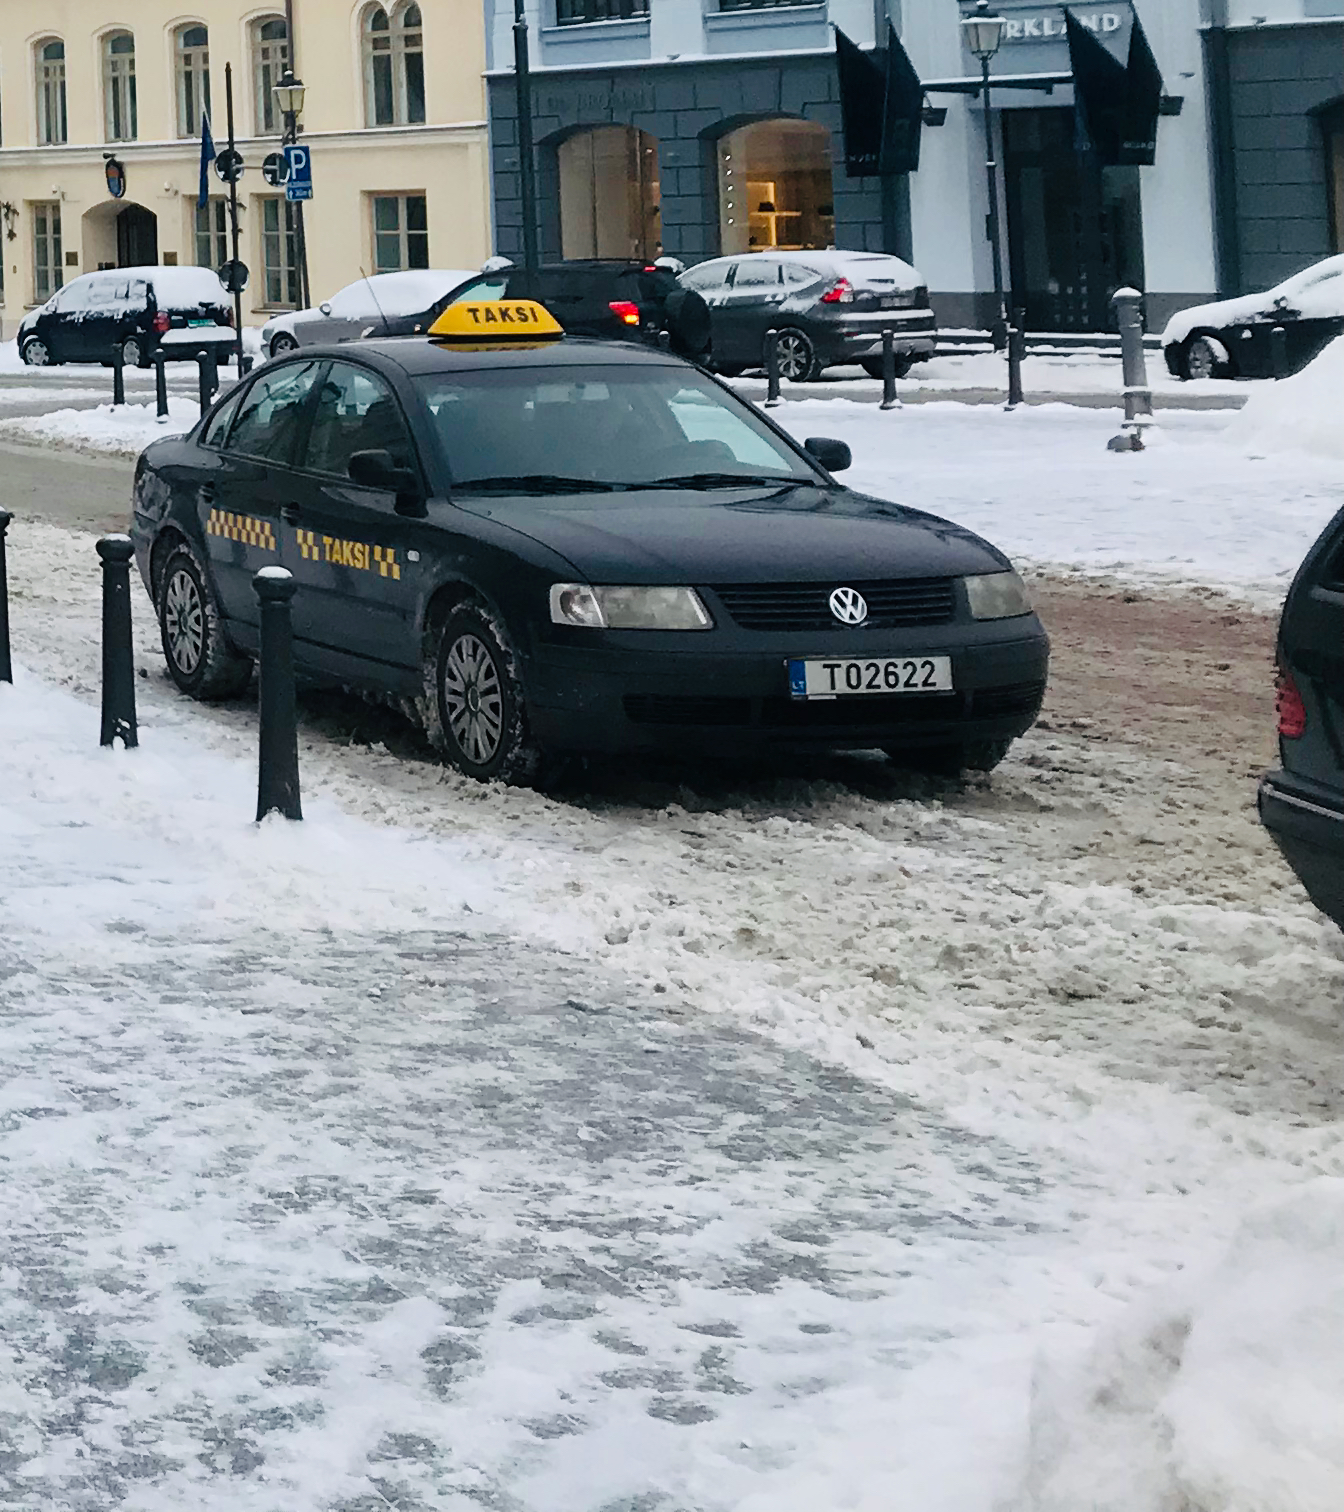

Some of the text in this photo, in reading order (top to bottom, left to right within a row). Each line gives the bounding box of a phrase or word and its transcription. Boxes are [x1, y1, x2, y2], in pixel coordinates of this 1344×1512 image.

[290, 149, 307, 180] P
[467, 306, 538, 324] TAKSI
[323, 536, 370, 570] TAKSI
[792, 660, 937, 691] LT T02622
